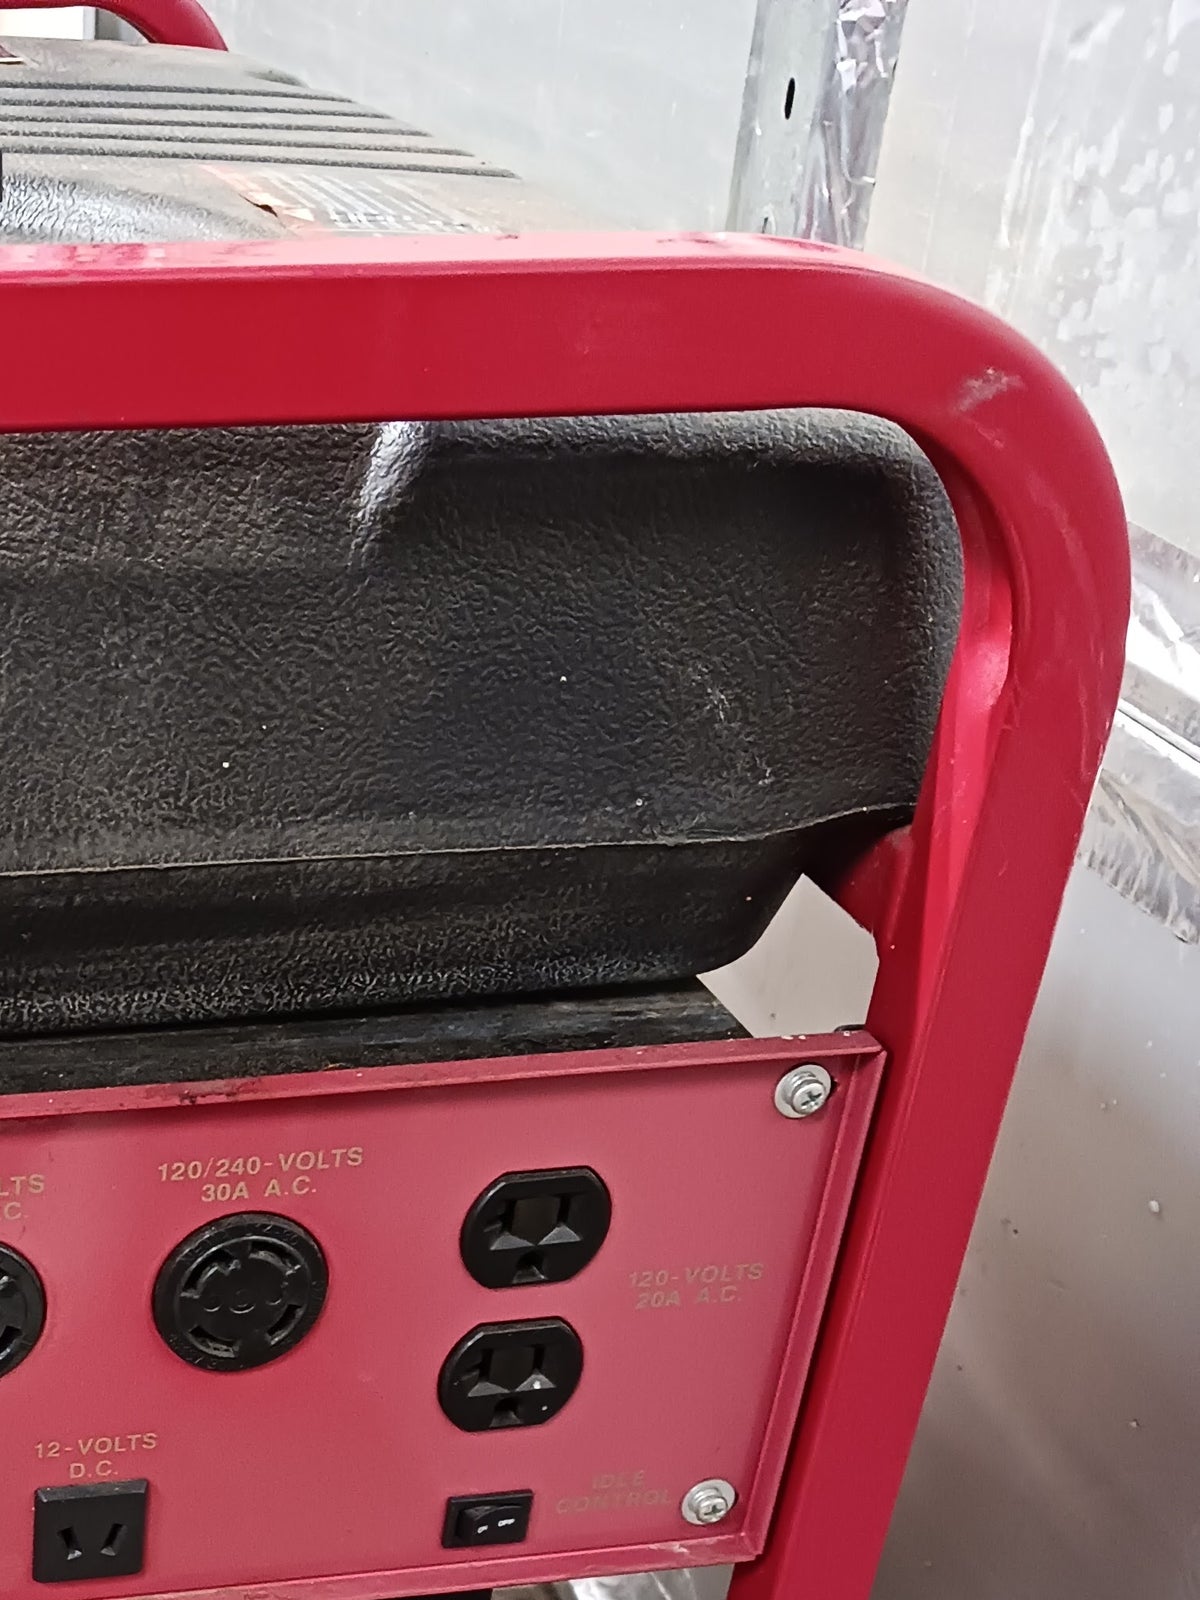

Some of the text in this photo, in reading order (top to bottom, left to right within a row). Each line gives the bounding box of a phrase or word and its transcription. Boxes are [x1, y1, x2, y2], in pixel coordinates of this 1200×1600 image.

[158, 1146, 364, 1182] 120/240-VOLTS
[201, 1175, 318, 1202] 30A A.C.
[629, 1262, 764, 1288] 120-VOLTS
[634, 1290, 681, 1310] 20A
[34, 1432, 157, 1458] 12-VOLTS
[69, 1460, 119, 1479] D.C.
